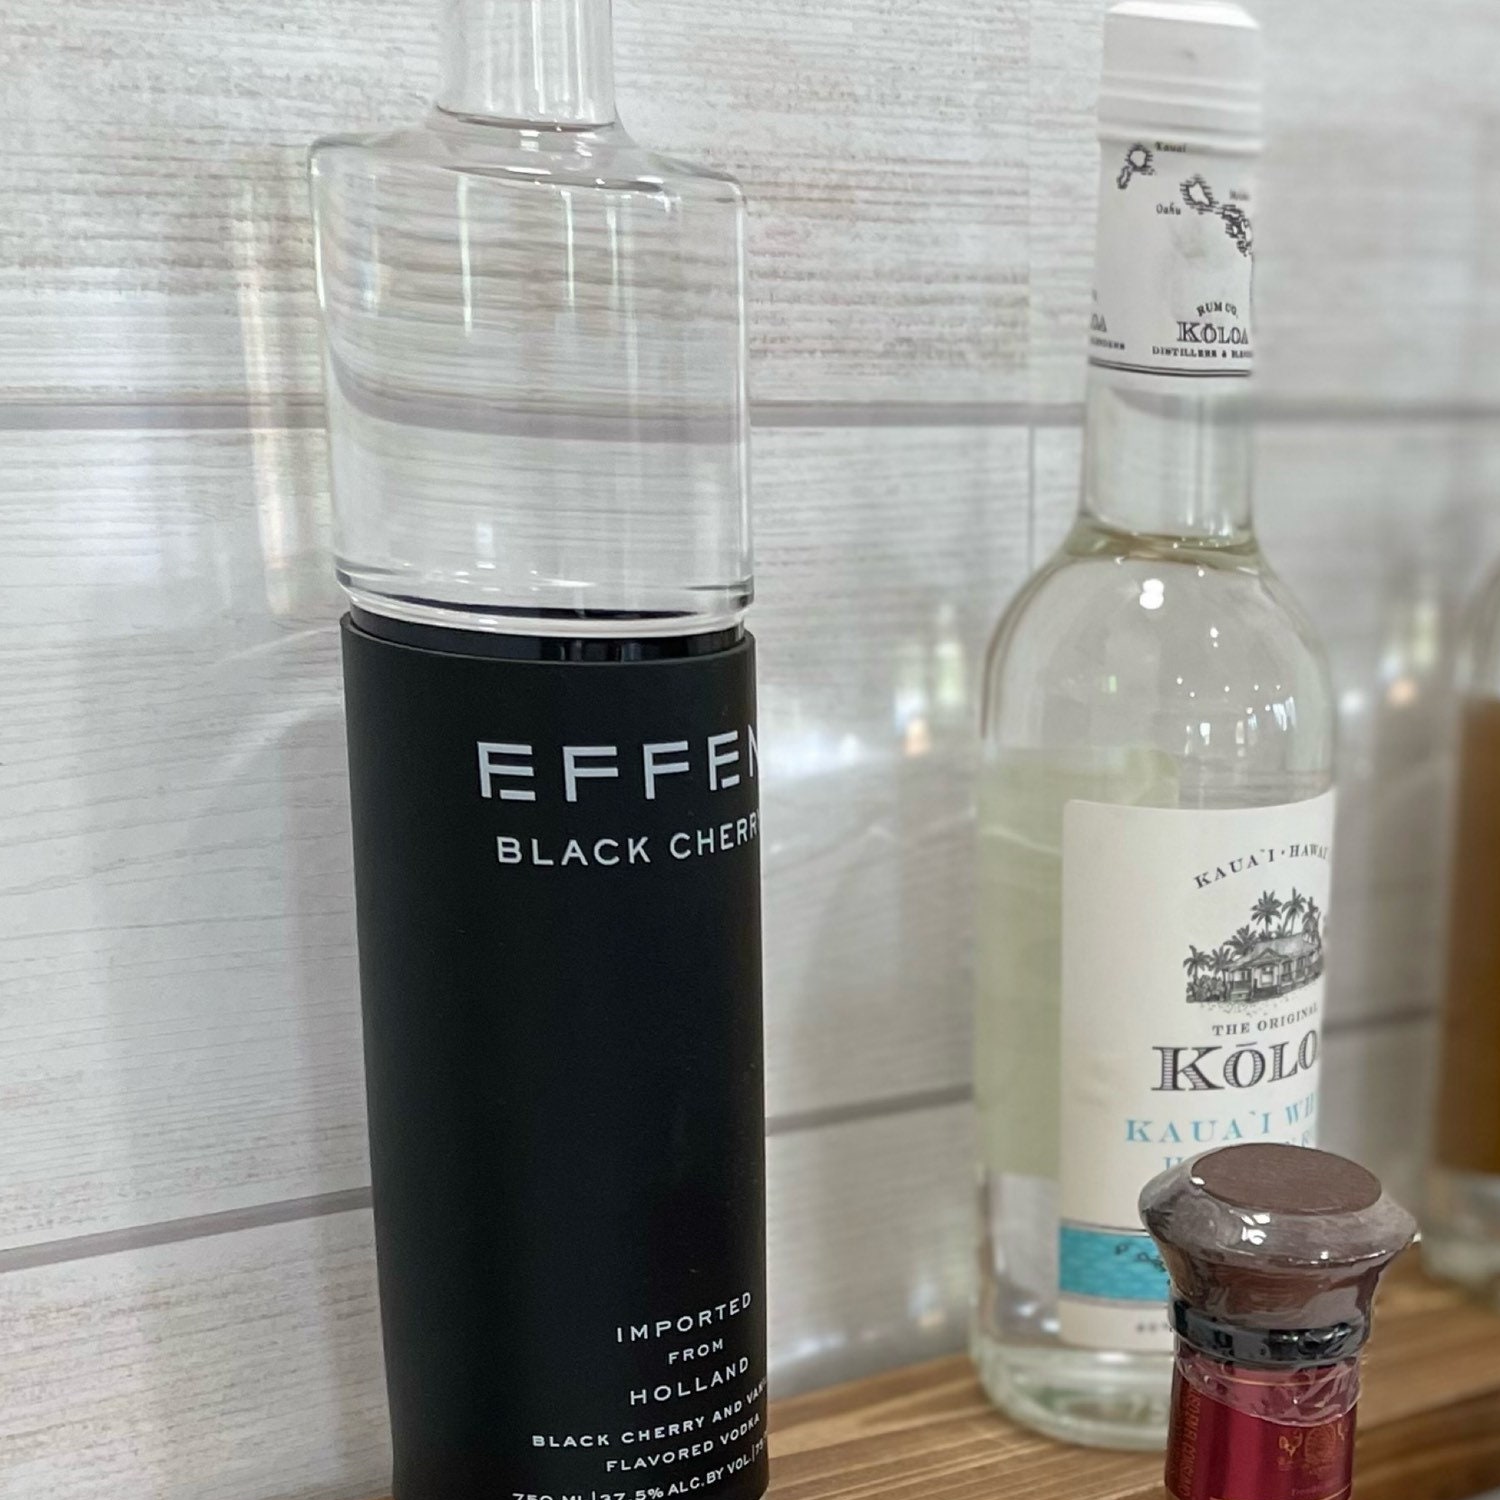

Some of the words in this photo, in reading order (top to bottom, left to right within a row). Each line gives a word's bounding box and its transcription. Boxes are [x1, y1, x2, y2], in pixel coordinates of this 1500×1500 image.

[1156, 202, 1182, 216] Oahu
[1196, 301, 1223, 318] RUM
[496, 835, 652, 866] BLACK
[1211, 1021, 1251, 1036] THE
[1150, 1029, 1319, 1092] KŌLO
[616, 1291, 752, 1343] IMPORTED
[667, 1337, 724, 1365] FROM
[629, 1356, 750, 1406] HOLLAND
[531, 1433, 611, 1448] BLACK
[620, 1415, 705, 1444] CHERRY
[711, 1399, 743, 1424] AND
[605, 1439, 715, 1473] FLAVORED
[719, 1412, 761, 1446] VODKA
